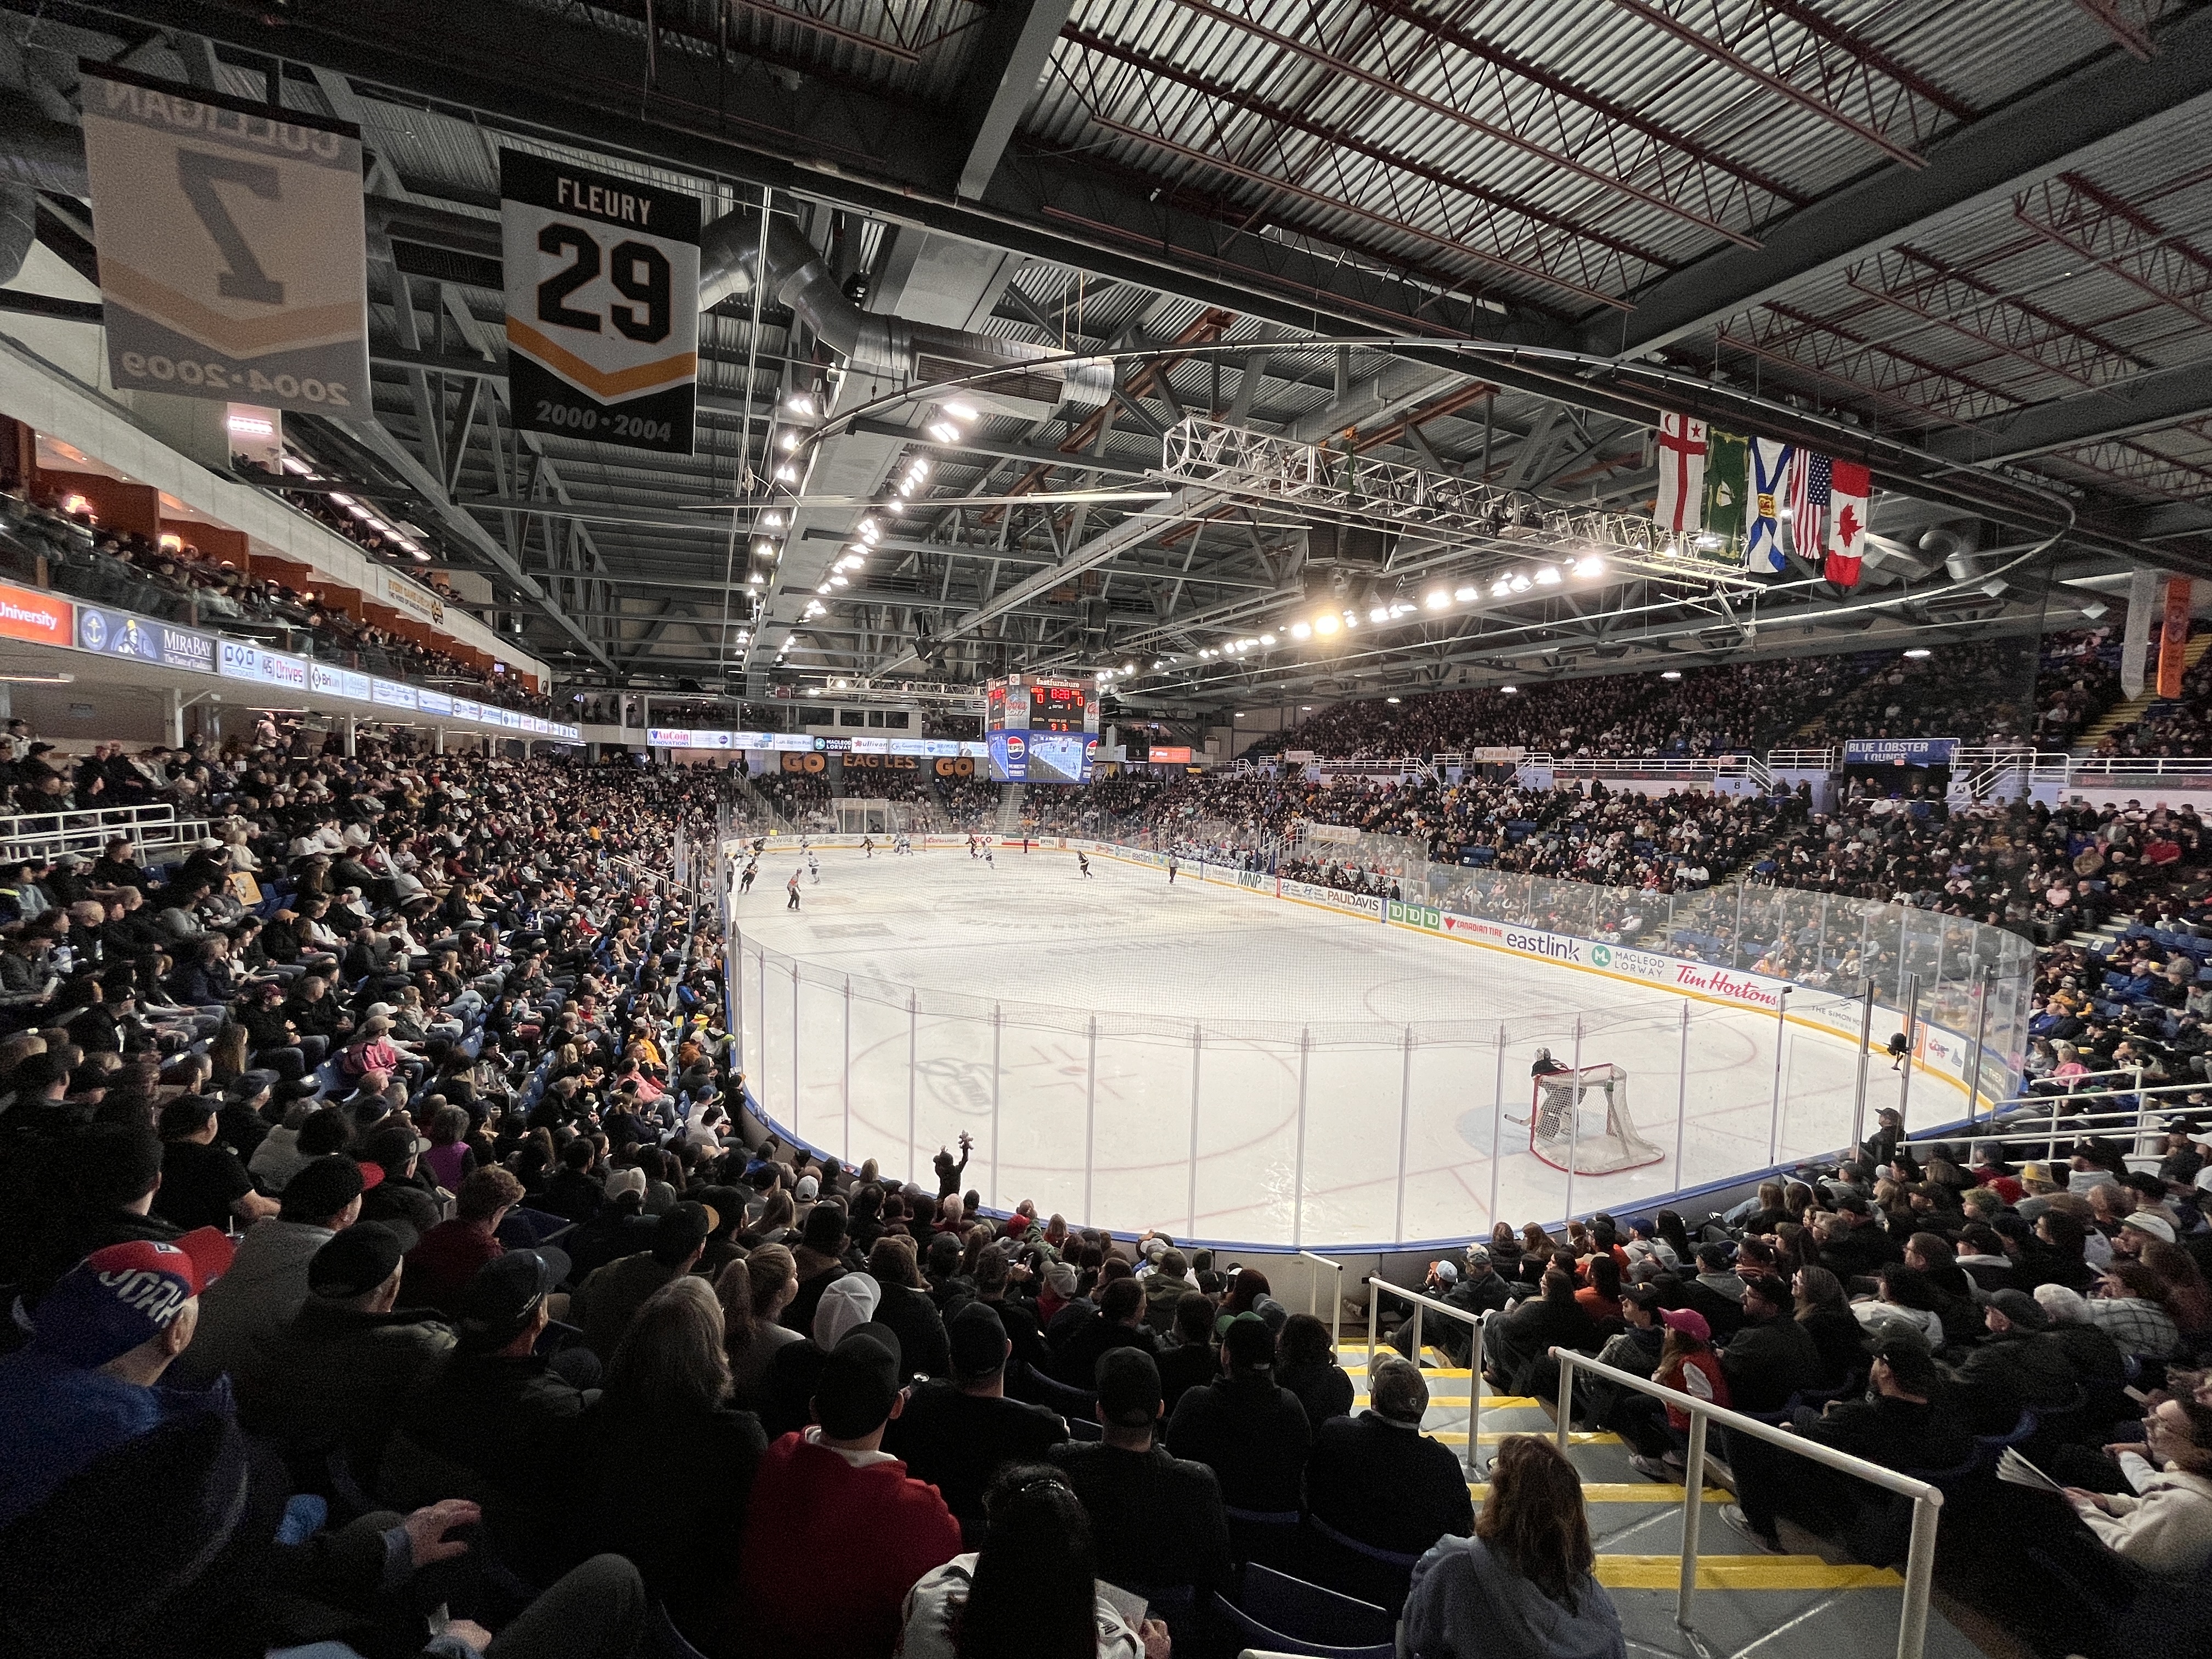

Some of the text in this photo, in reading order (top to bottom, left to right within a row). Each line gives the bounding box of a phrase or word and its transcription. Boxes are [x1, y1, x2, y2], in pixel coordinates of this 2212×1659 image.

[557, 177, 652, 225] FLEURY
[537, 222, 673, 345] 29
[276, 661, 303, 683] Drives
[1036, 677, 1080, 688] fastfurniture
[1849, 742, 1928, 752] BLUE LOBSTER
[782, 752, 825, 772] GO
[936, 757, 973, 776] GO
[1238, 871, 1262, 888] MNP
[1457, 920, 1502, 937] CANADIAN TIRE
[1506, 933, 1579, 961] eastlink
[1615, 951, 1664, 968] MACLEOD
[1615, 962, 1663, 977] LORWAY
[1677, 964, 1776, 1005] Tim Hortons
[1811, 1005, 1826, 1015] THE
[1829, 1009, 1852, 1021] SIMON
